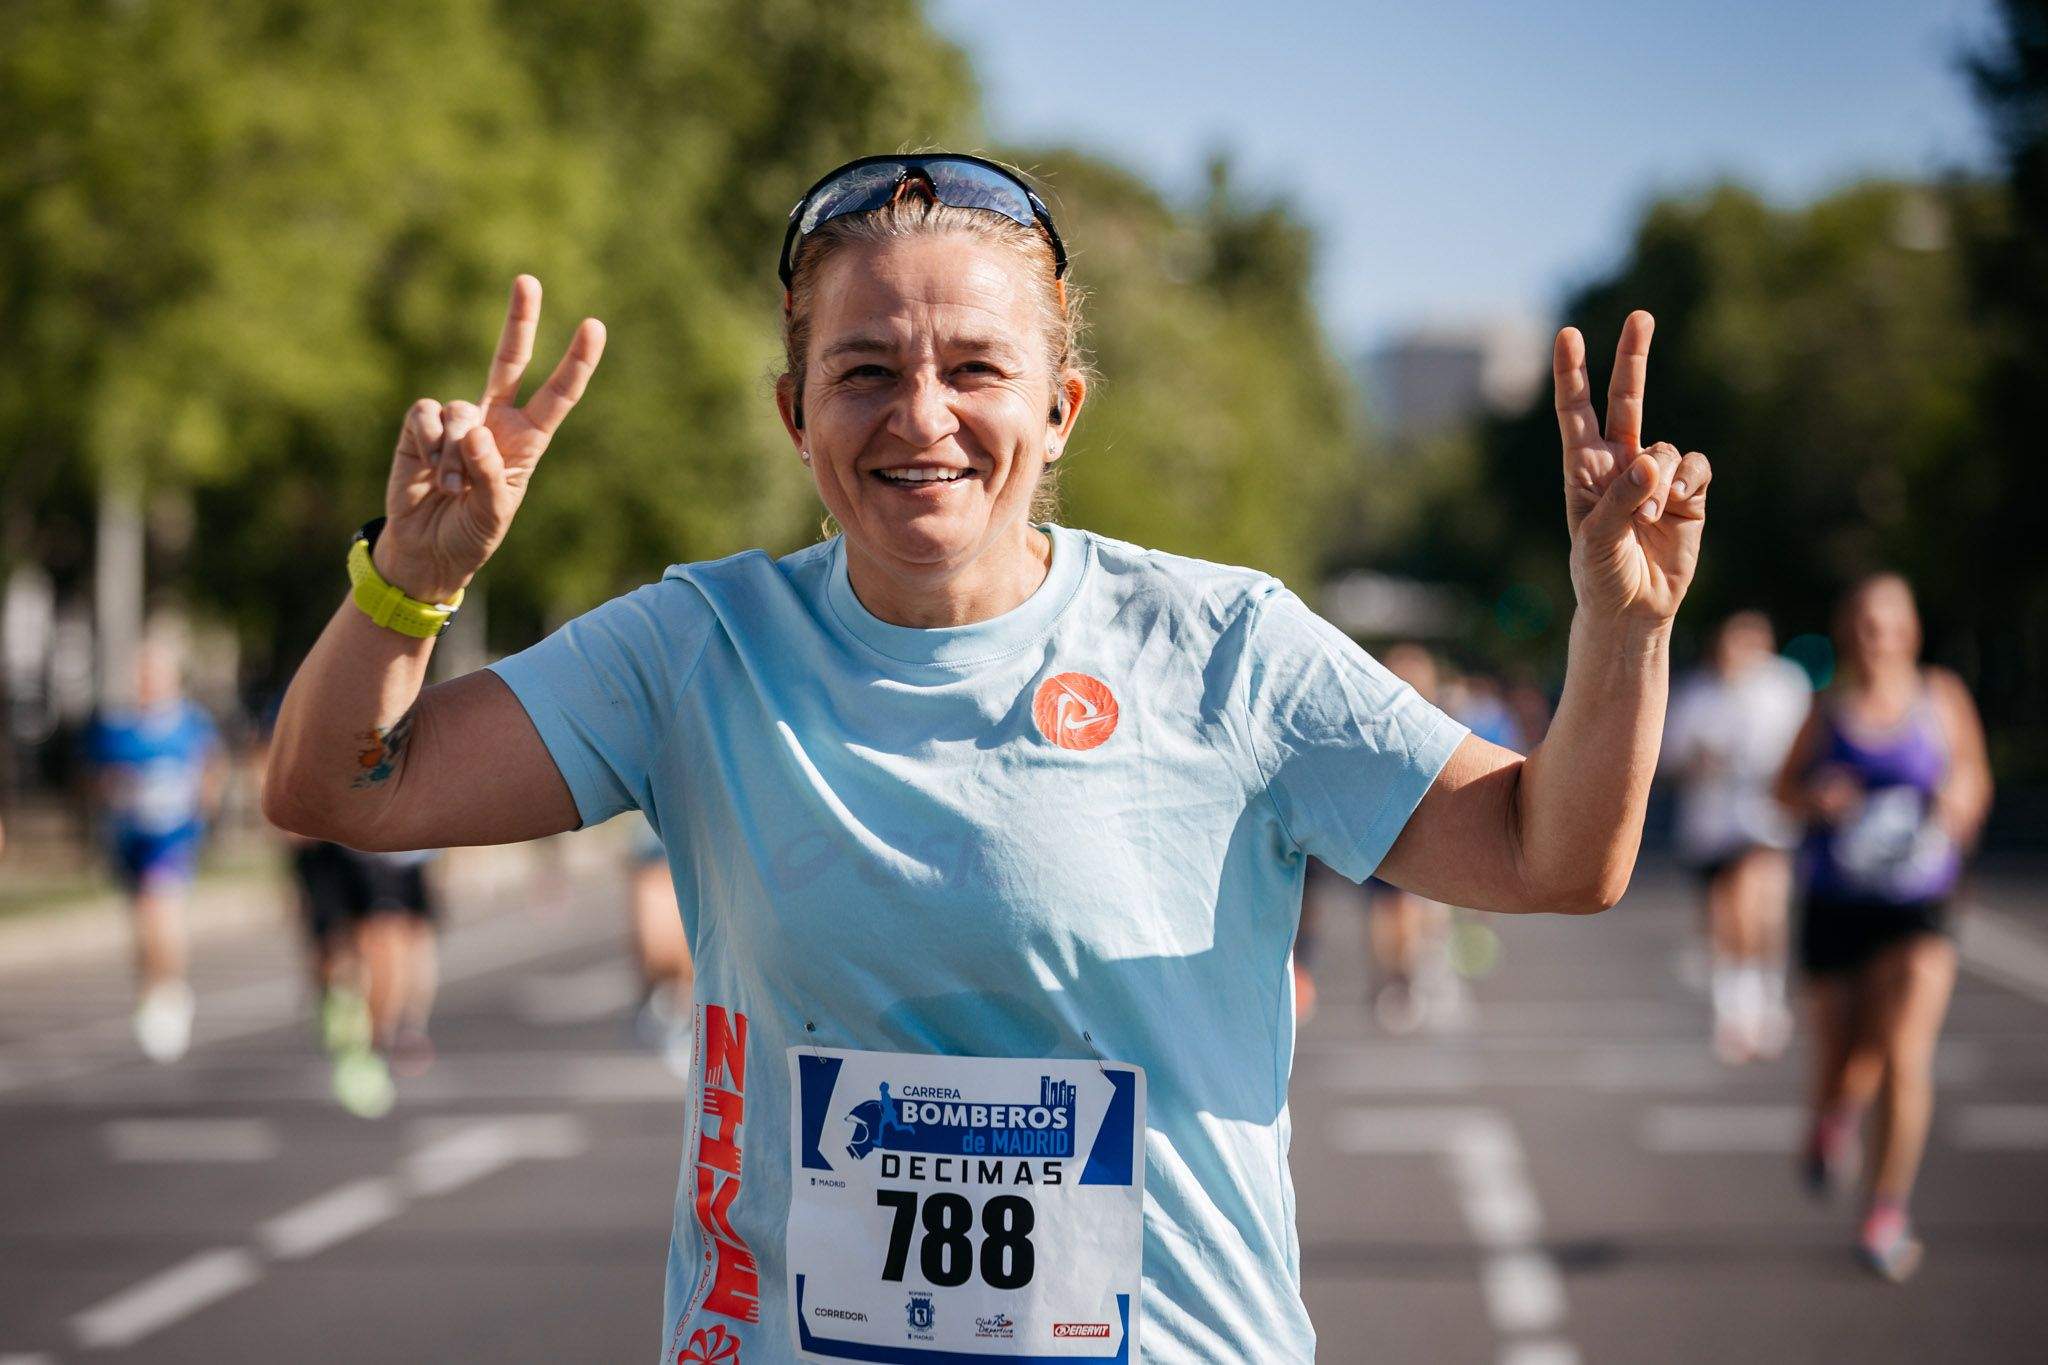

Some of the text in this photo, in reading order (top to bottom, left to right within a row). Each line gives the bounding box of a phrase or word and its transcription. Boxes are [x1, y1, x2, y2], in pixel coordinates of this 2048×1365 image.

[903, 1085, 961, 1099] CARRERA
[902, 1102, 1068, 1129] BOMBEROS
[962, 1129, 1068, 1155] de MADRID
[695, 1005, 759, 1324] NIKE
[881, 1154, 1062, 1185] DECIMAS
[819, 1178, 846, 1188] MADRID
[877, 1189, 1035, 1290] 788
